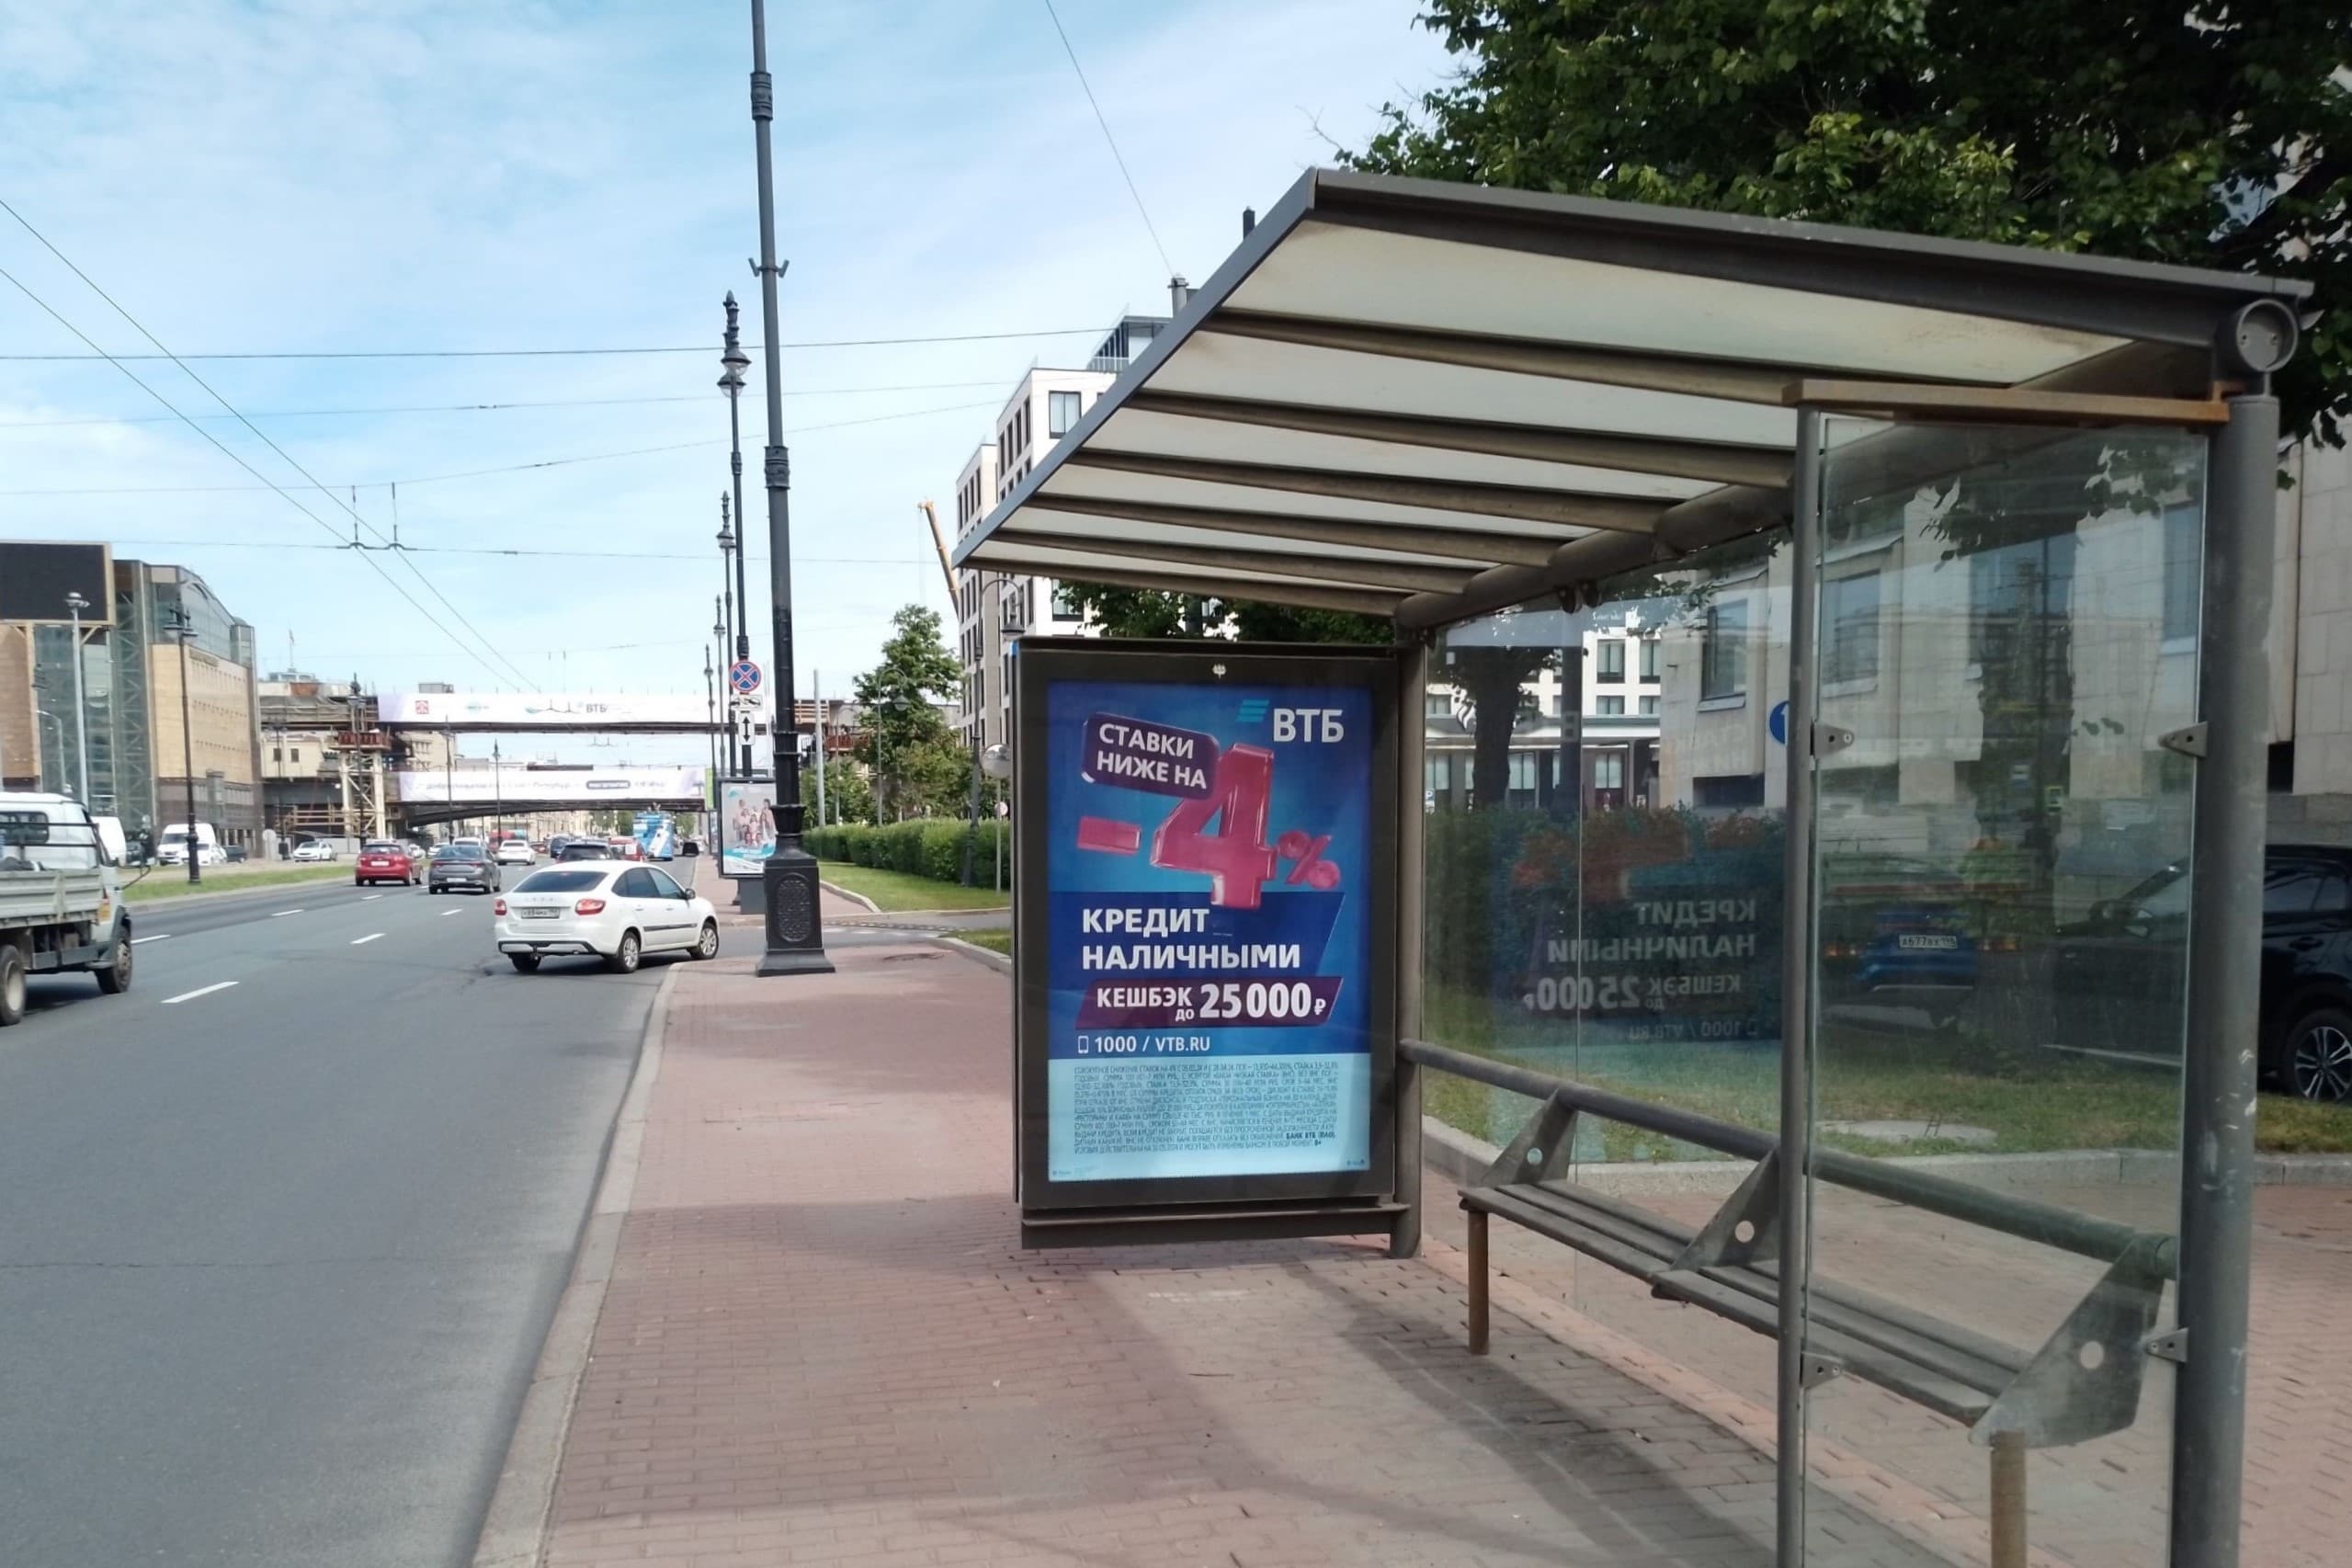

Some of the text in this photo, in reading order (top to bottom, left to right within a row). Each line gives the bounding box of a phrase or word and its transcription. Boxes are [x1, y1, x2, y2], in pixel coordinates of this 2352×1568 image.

[1099, 722, 1194, 758] СТАВКИ
[1273, 708, 1345, 744] ВТБ
[1096, 750, 1207, 789] НИЖЕ НА
[1082, 908, 1210, 938] КРЕДИТ
[1082, 944, 1301, 971] НАЛИЧНЫМИ
[1097, 986, 1193, 1009] КЕШБЭК
[1095, 1037, 1137, 1052] 1000
[1155, 1036, 1210, 1052] VTB.RU
